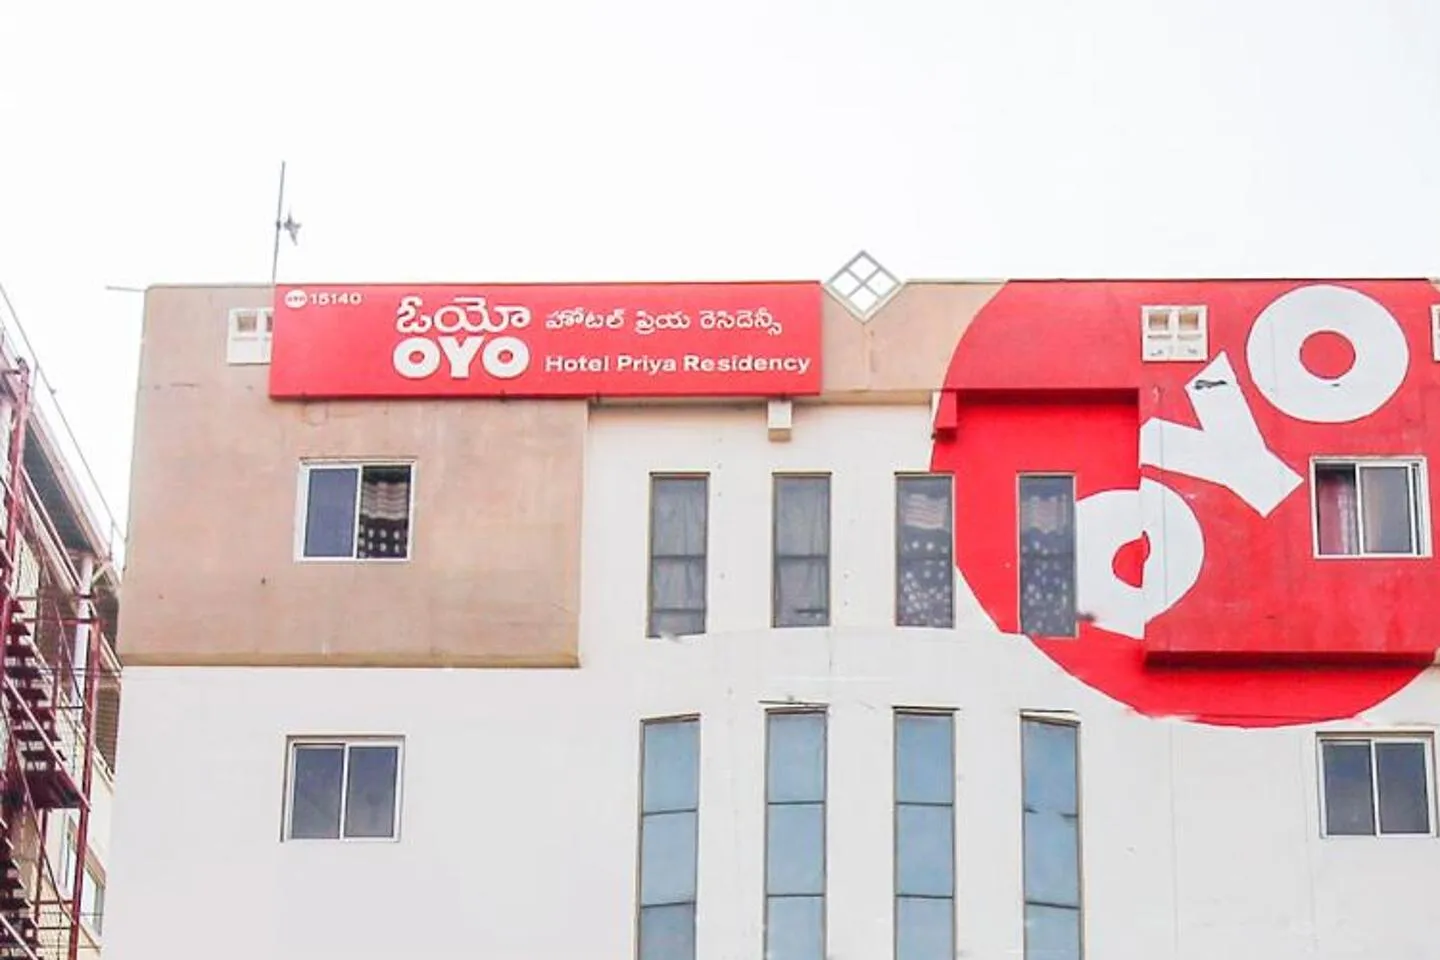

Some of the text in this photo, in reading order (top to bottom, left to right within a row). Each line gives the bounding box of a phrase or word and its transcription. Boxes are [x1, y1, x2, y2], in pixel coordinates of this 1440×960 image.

[310, 292, 362, 305] 15140
[396, 296, 531, 333] ఓయో
[545, 307, 625, 329] హోటల్
[635, 310, 691, 335] ప్రియ
[392, 336, 531, 379] OYO
[545, 355, 810, 374] Hotel Priya Residency
[1076, 284, 1409, 640] OYO
